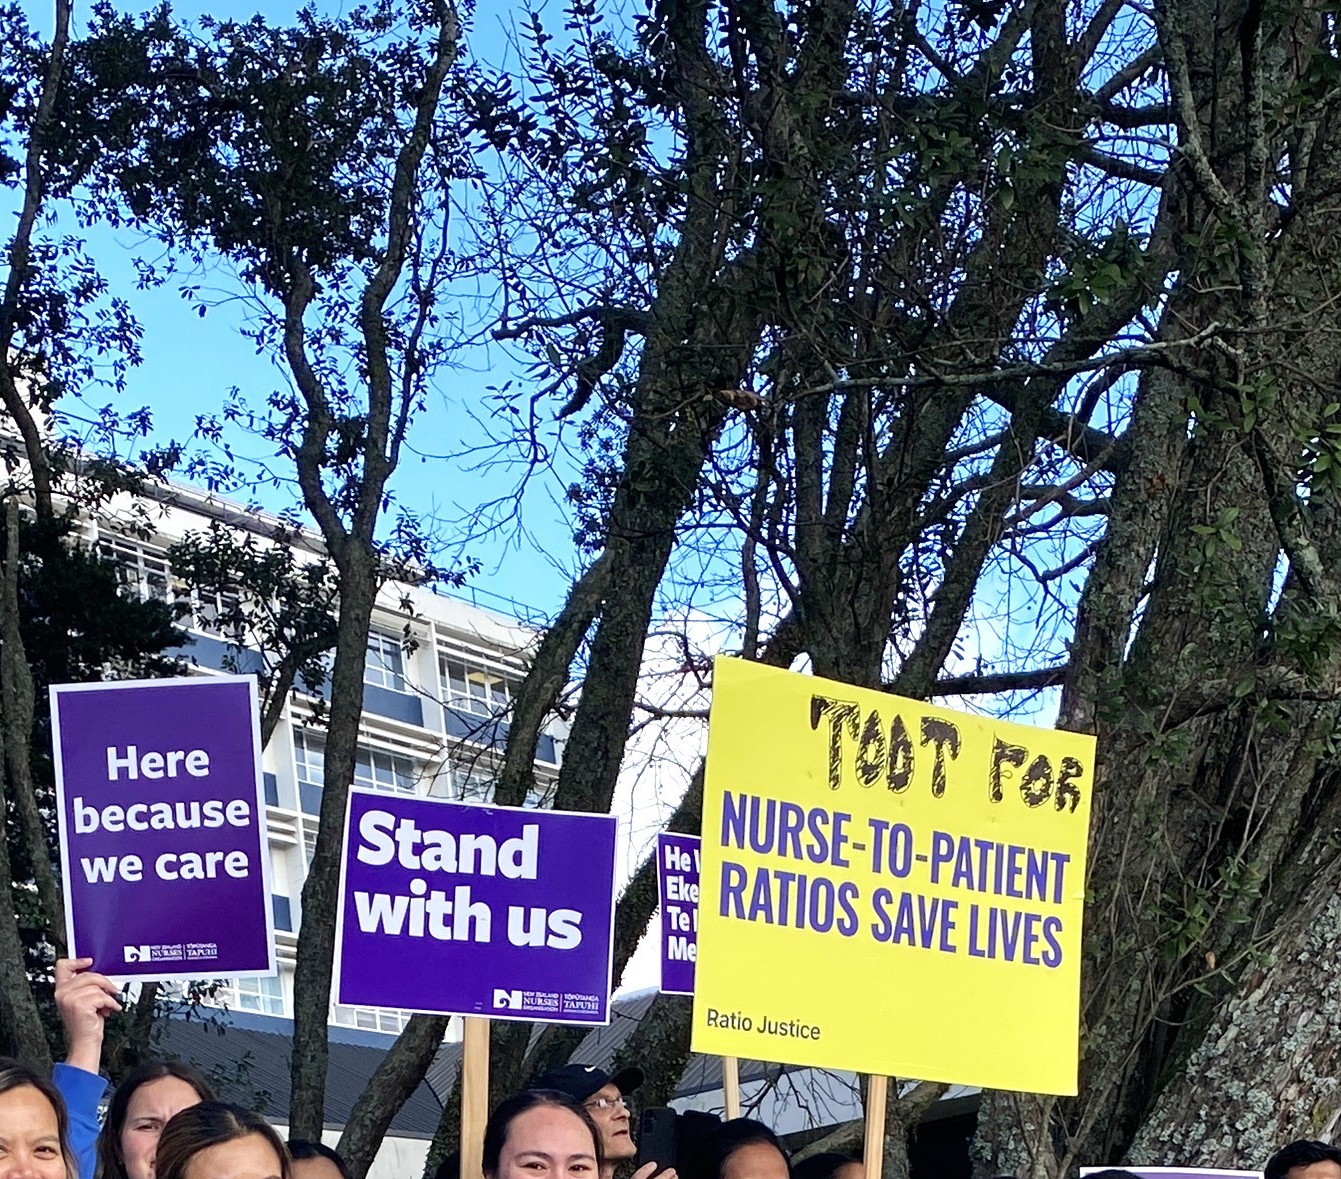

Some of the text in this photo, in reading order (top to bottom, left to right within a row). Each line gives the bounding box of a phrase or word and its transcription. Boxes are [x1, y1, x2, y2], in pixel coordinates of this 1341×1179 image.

[107, 745, 210, 781] Here
[810, 694, 1084, 815] TOOT FOR
[73, 797, 251, 834] because
[357, 810, 540, 880] Stand
[664, 845, 691, 873] He
[720, 790, 1070, 905] NURSE-TO-PATIENT
[80, 850, 249, 884] we care
[354, 878, 583, 950] with us
[667, 905, 690, 932] Te
[719, 861, 1063, 969] RATIOS SAVE LIVES
[523, 997, 559, 1007] NURSES
[706, 1007, 821, 1041] Ratio Justice
